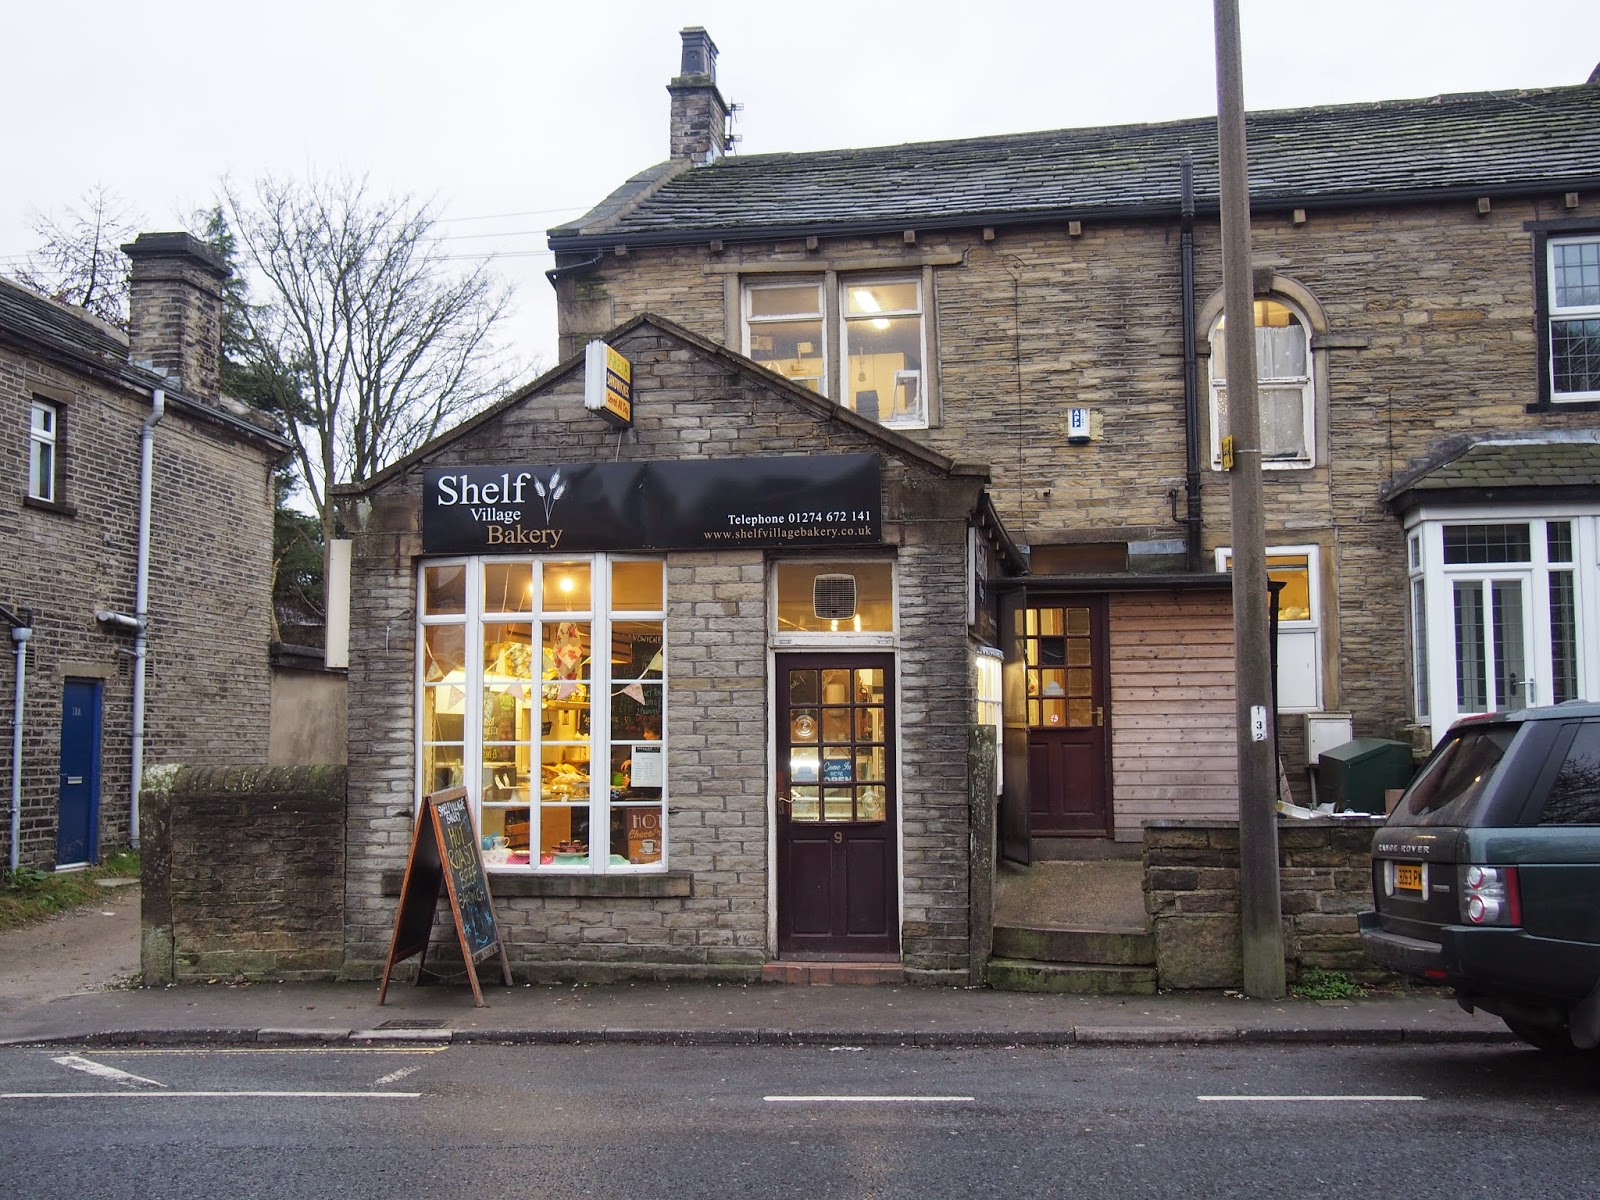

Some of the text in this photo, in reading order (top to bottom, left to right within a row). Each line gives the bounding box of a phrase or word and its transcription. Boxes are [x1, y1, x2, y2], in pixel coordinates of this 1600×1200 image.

[438, 472, 532, 506] Shelf
[470, 507, 522, 524] Village
[728, 511, 871, 526] Telephone 01274 672 141
[486, 523, 563, 549] Bakery
[704, 525, 872, 540] www.shelfvillagebakery.co.uk
[824, 761, 842, 772] Come
[632, 814, 662, 828] HOT
[448, 822, 465, 849] HOT
[834, 831, 843, 844] 9
[1379, 843, 1430, 854] RANGE ROVER
[448, 840, 477, 874] ROAST
